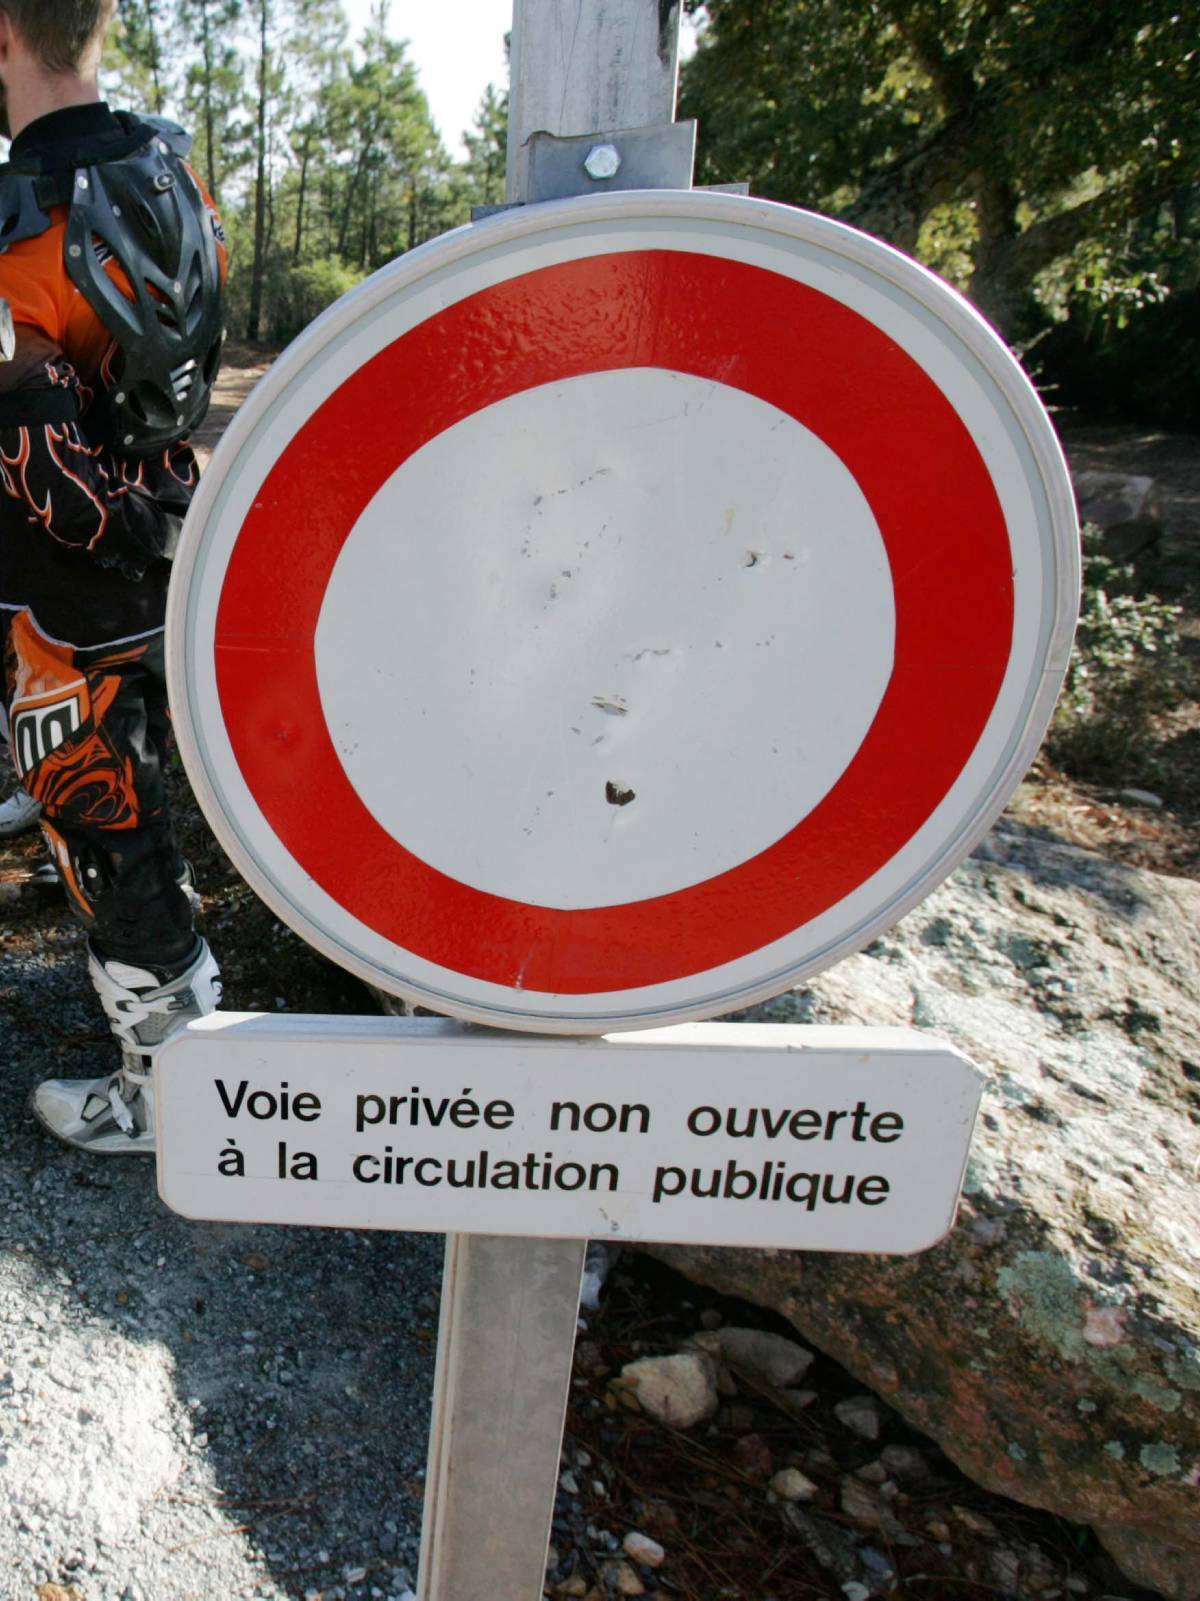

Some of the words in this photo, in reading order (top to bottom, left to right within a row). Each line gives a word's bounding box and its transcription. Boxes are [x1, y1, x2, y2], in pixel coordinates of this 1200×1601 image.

[214, 1079, 322, 1122] Voie
[354, 1086, 515, 1134] privée
[550, 1101, 650, 1134] non
[687, 1101, 904, 1144] ouverte
[217, 1138, 246, 1177] à
[278, 1141, 318, 1181] la
[352, 1145, 619, 1192] circulation
[652, 1161, 890, 1212] publique
